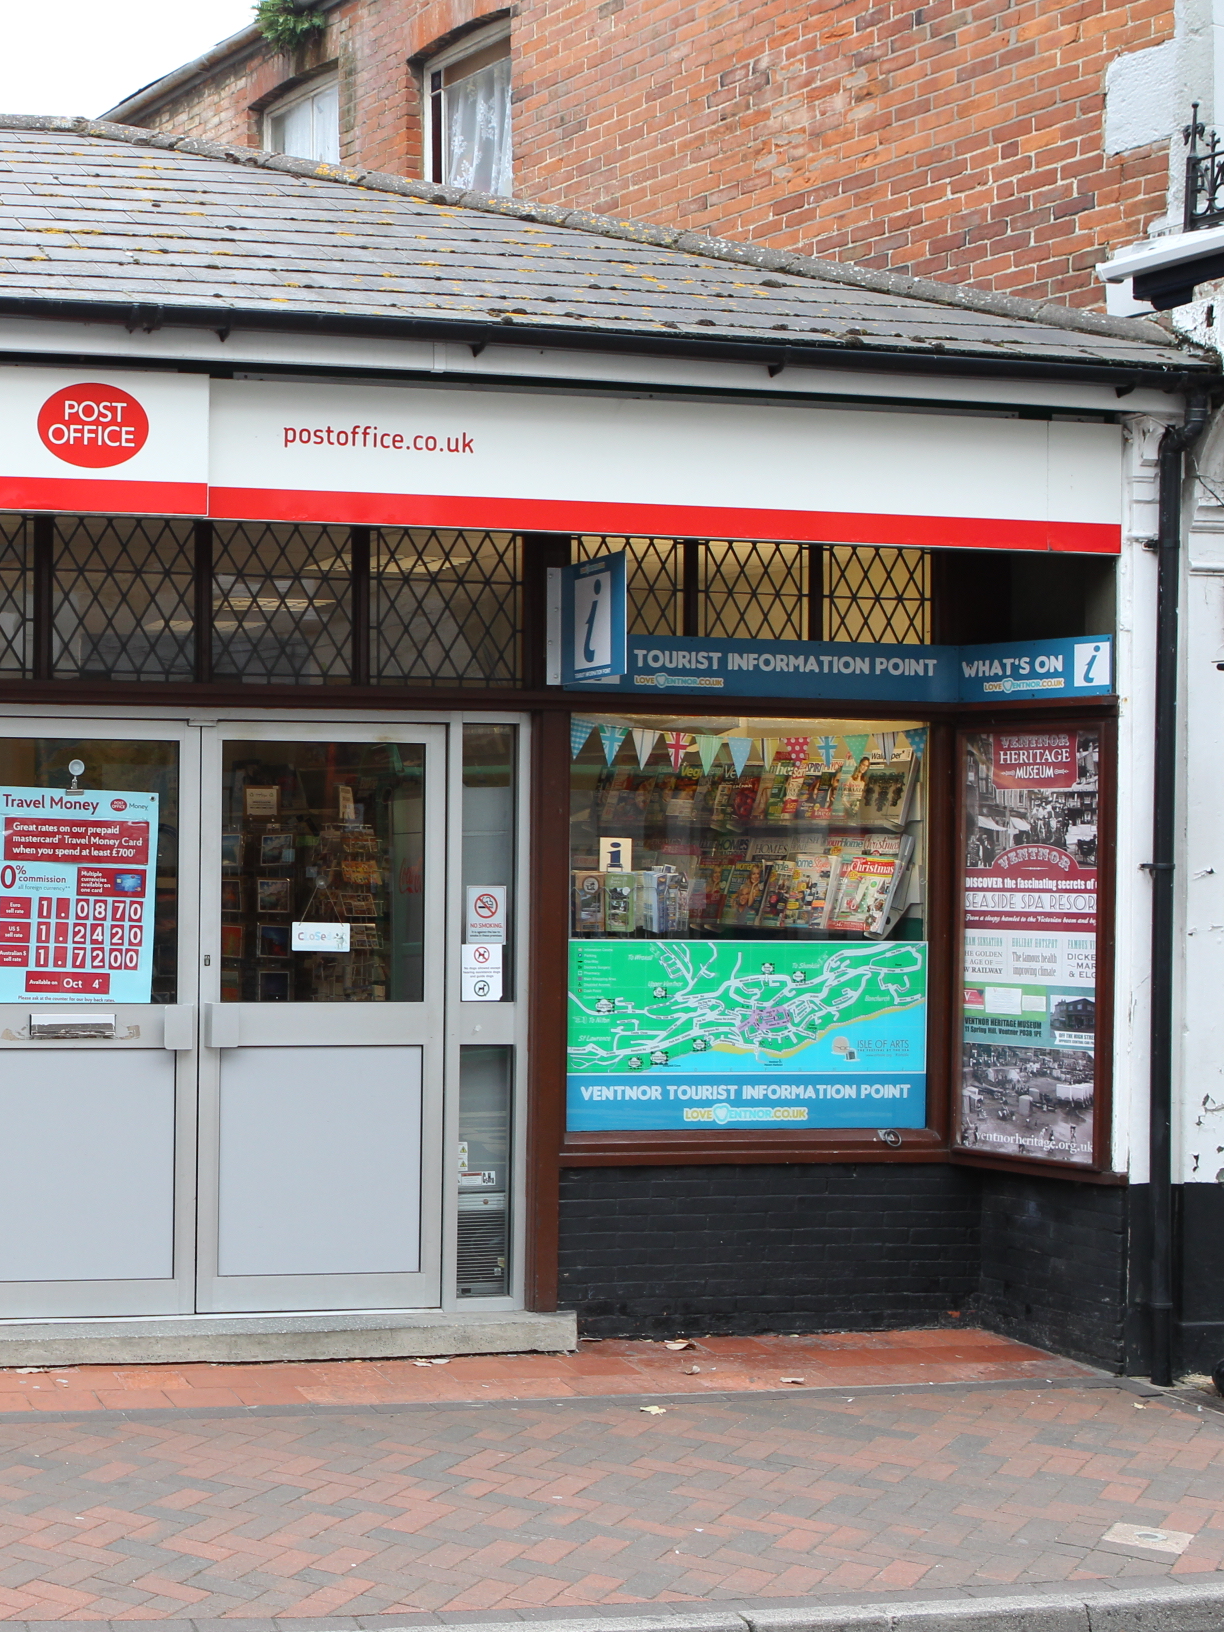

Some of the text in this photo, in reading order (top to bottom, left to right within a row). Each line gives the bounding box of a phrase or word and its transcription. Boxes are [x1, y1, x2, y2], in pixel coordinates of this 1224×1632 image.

[63, 400, 127, 423] POST
[48, 423, 136, 448] OFFICE
[283, 424, 474, 455] postoffice.co.uk
[634, 648, 938, 677] TOURIST INFORMATION POINT
[1034, 655, 1064, 674] ON
[1000, 734, 1069, 748] VENTNOR
[999, 749, 1071, 764] HERITAGE
[1015, 766, 1054, 779] MUSEUM
[3, 794, 99, 815] Travel Money
[12, 822, 36, 831] Great
[38, 824, 57, 832] rates
[88, 825, 119, 836] prepaid
[63, 835, 89, 845] Travel
[90, 837, 120, 846] Money
[121, 837, 143, 846] Card
[38, 849, 54, 857] you
[55, 848, 80, 857] spend
[91, 849, 110, 857] least
[998, 847, 1071, 872] VENTNOR
[850, 861, 894, 874] Christmas
[18, 875, 66, 883] commission
[965, 877, 1095, 891] DISCOVER the fascinating secrets of
[966, 893, 1096, 910] SEASIDE SPA RESOR
[984, 915, 1000, 923] sleepy
[977, 936, 1003, 947] SENSATION
[1012, 937, 1057, 949] HOLIDAY HOTSPOT
[1068, 939, 1088, 949] FAMOUS
[1012, 952, 1057, 964] The famous health
[1013, 965, 1056, 977] improving climate
[63, 978, 83, 988] Oct
[965, 1017, 1042, 1029] VENTNOR HERITAGE MUSEUM
[970, 1026, 987, 1034] Spring
[857, 1040, 909, 1048] ISLE OF ARTS
[580, 1084, 911, 1100] VENTNOR TOURIST INFORMATION POINT
[976, 1132, 1093, 1154] ventnorheritage.org.uk
